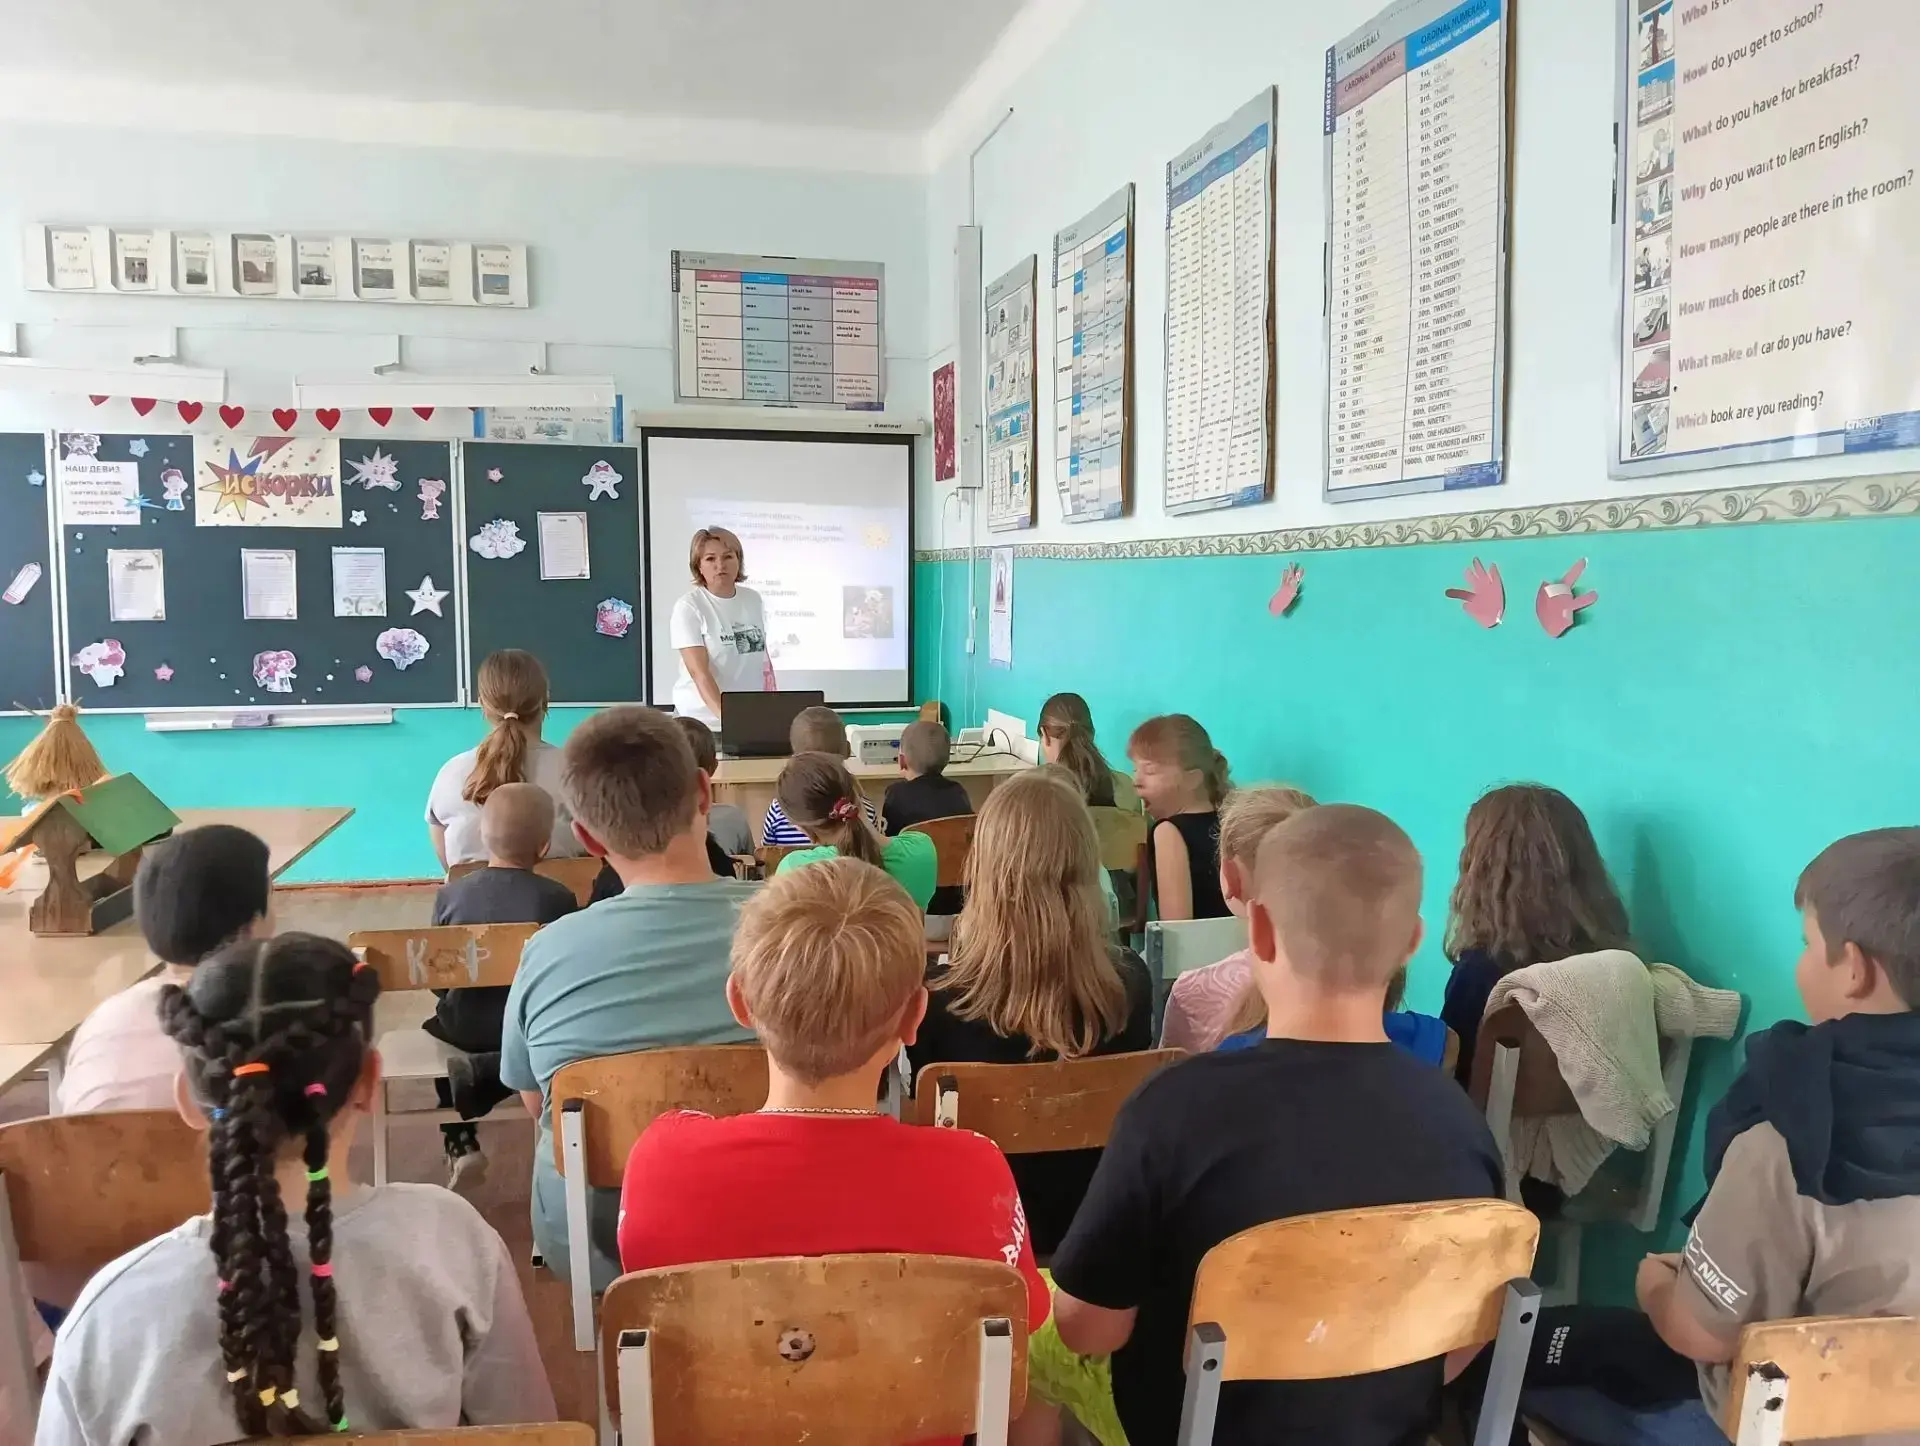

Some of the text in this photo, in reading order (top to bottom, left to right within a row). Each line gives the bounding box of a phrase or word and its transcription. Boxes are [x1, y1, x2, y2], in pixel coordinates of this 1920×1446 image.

[1420, 22, 1450, 44] ORDINAL
[1682, 4, 1708, 26] Who
[1346, 29, 1380, 60] NUMERALS
[1682, 3, 1823, 84] How do you get to school?
[1344, 51, 1396, 92] CARDINAL NUMERALS
[1682, 54, 1860, 143] What do you have for breakfast?
[1433, 132, 1456, 148] SEVENTH
[1680, 118, 1869, 202] Why do you want to learn English?
[1433, 183, 1459, 200] ELEVENTH
[1679, 168, 1914, 259] How many people are there in the room?
[1678, 269, 1806, 317] How much does it cost?
[1432, 319, 1472, 338] TWENTY-SECOND
[1678, 320, 1852, 373] What make of car do you have?
[1675, 390, 1824, 430] Which book are you reading?
[1426, 441, 1436, 450] ONE
[1437, 437, 1460, 448] HUNDRED
[1470, 432, 1485, 442] FIRST
[1427, 429, 1437, 438] ONE
[89, 465, 120, 473] ДЕВИЗ
[1425, 453, 1436, 462] ONE
[1697, 1262, 1739, 1305] NIKE
[1546, 1327, 1562, 1364] WEAR
[1553, 1326, 1570, 1366] SPORT
